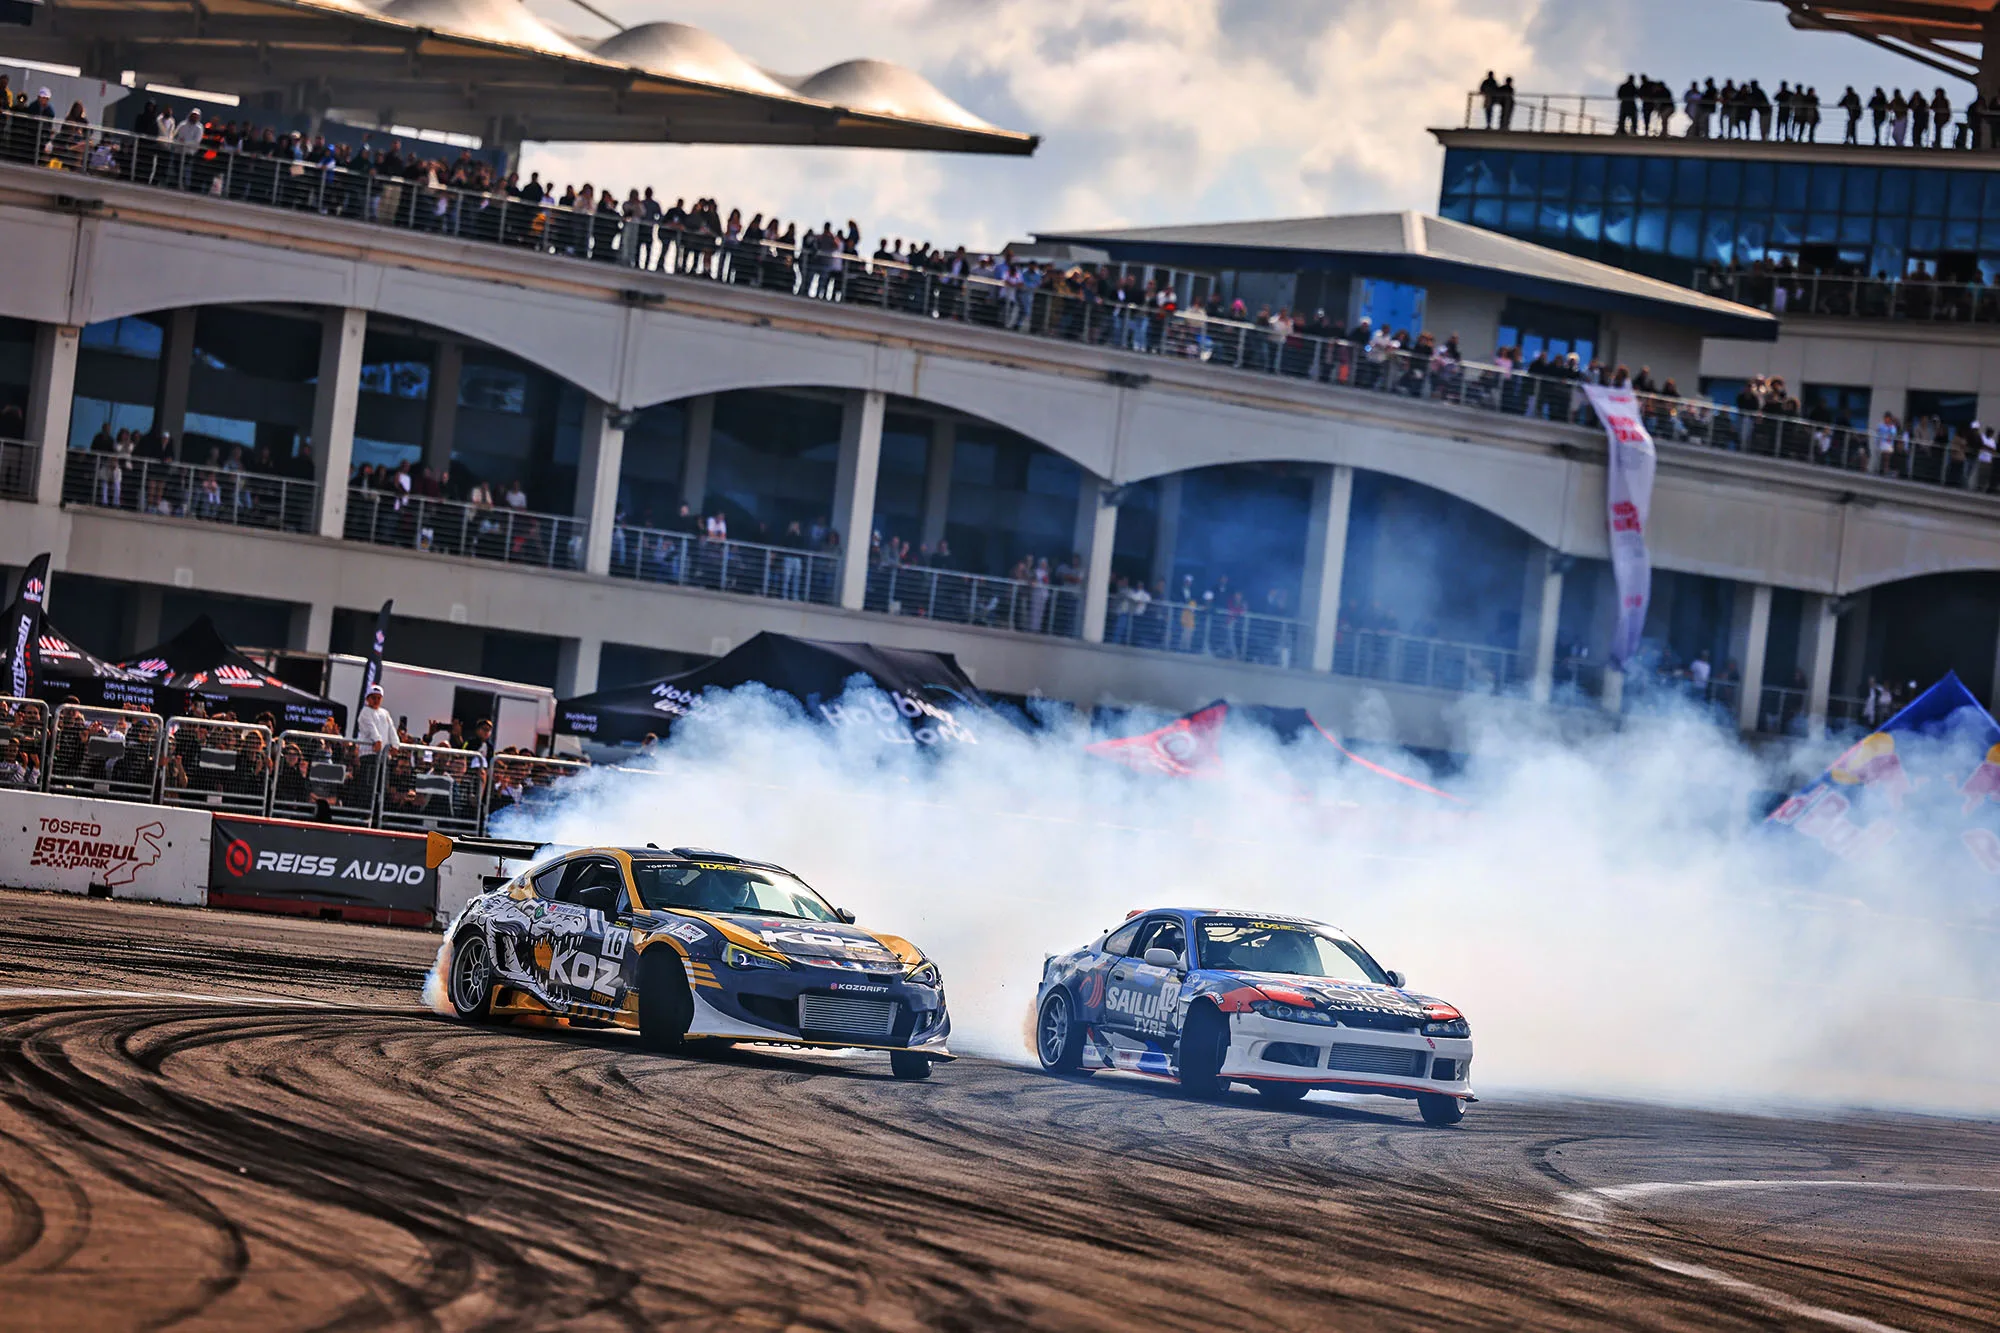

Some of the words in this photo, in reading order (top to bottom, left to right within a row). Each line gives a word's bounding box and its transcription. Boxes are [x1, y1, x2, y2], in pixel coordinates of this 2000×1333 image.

[103, 692, 116, 701] GO
[117, 693, 154, 705] FURTHER
[105, 682, 124, 692] DRIVE
[127, 684, 154, 695] HIGHER
[39, 818, 102, 838] TOSFED
[34, 836, 140, 863] ISTANBUL
[69, 857, 111, 870] PARK
[256, 850, 338, 877] REISS
[340, 859, 426, 886] AUDIO
[607, 929, 624, 959] 16
[759, 930, 889, 952] KOZ
[549, 945, 621, 997] KOZ
[838, 983, 889, 993] KOZDRIFT
[1163, 987, 1177, 1008] 12
[590, 991, 615, 1007] DRIFT
[1327, 1003, 1378, 1013] AUTO
[1133, 1016, 1168, 1037] TYRE
